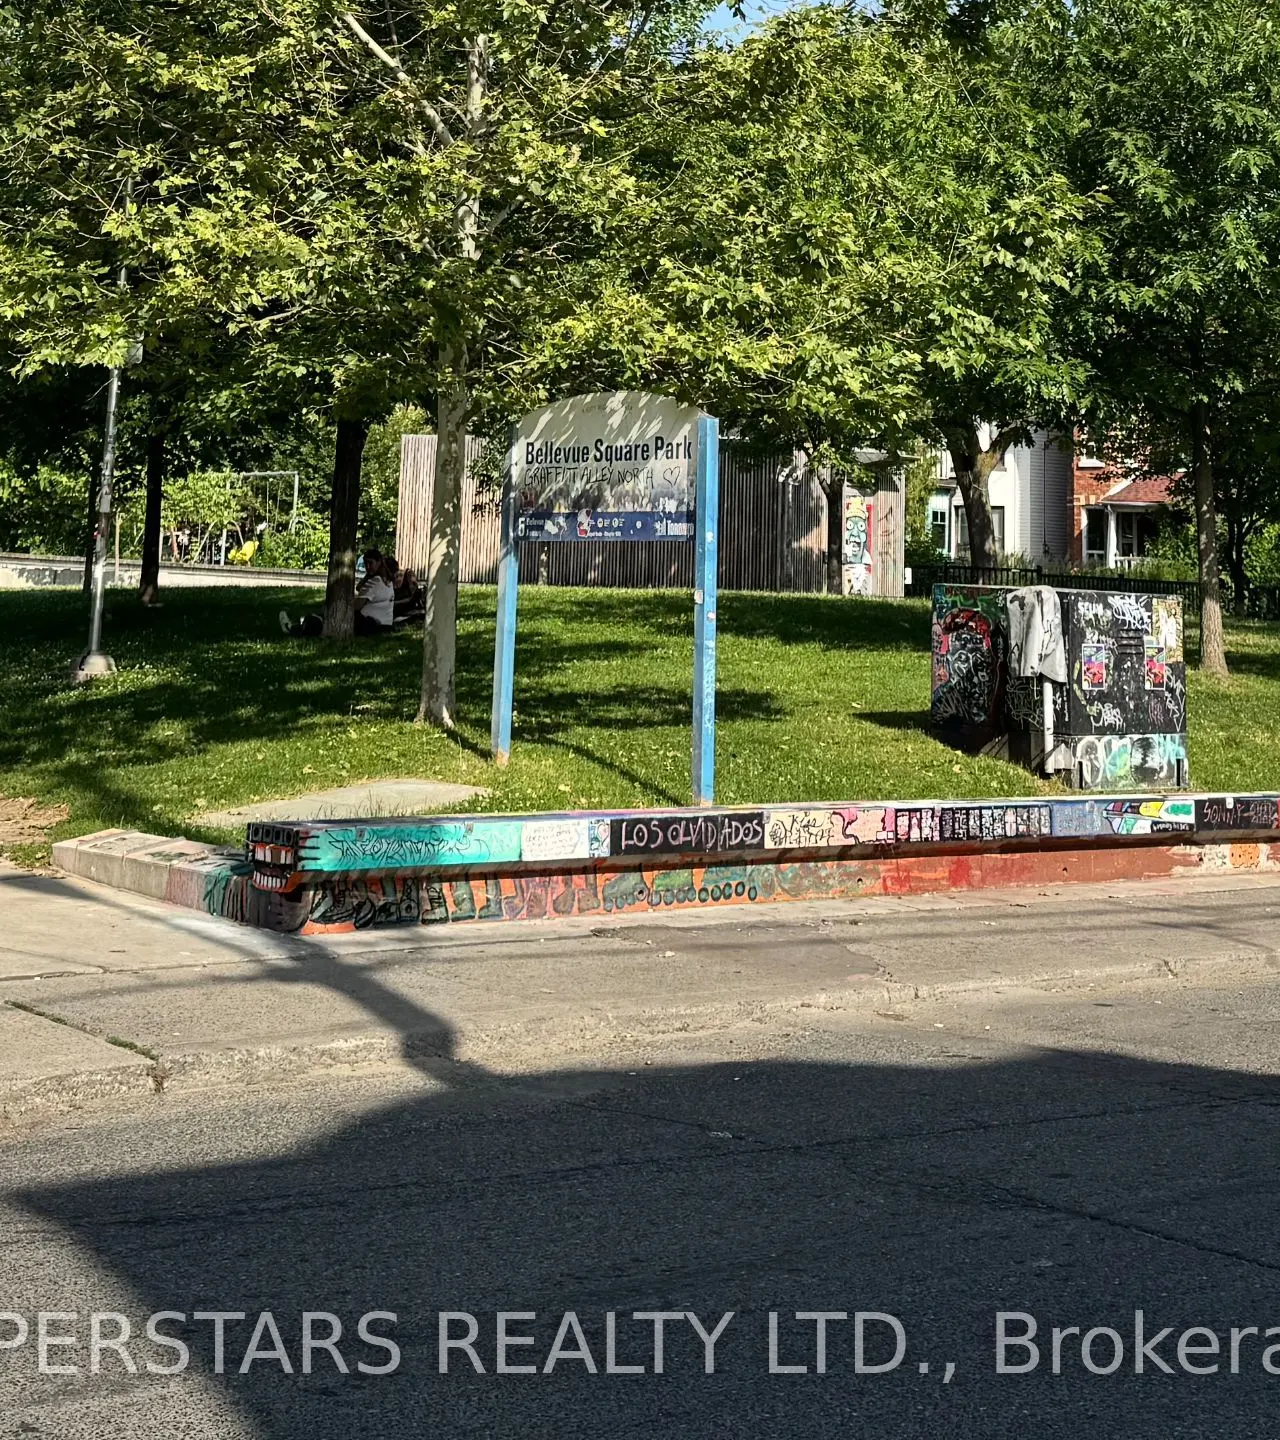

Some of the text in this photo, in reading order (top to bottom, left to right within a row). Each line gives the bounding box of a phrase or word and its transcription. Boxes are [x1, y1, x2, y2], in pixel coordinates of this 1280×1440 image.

[525, 435, 692, 466] Bellevue Square Park
[582, 466, 614, 484] ALLEY
[617, 467, 653, 488] NORTH
[620, 820, 663, 850] LOS
[667, 817, 763, 849] OLVIDADOS
